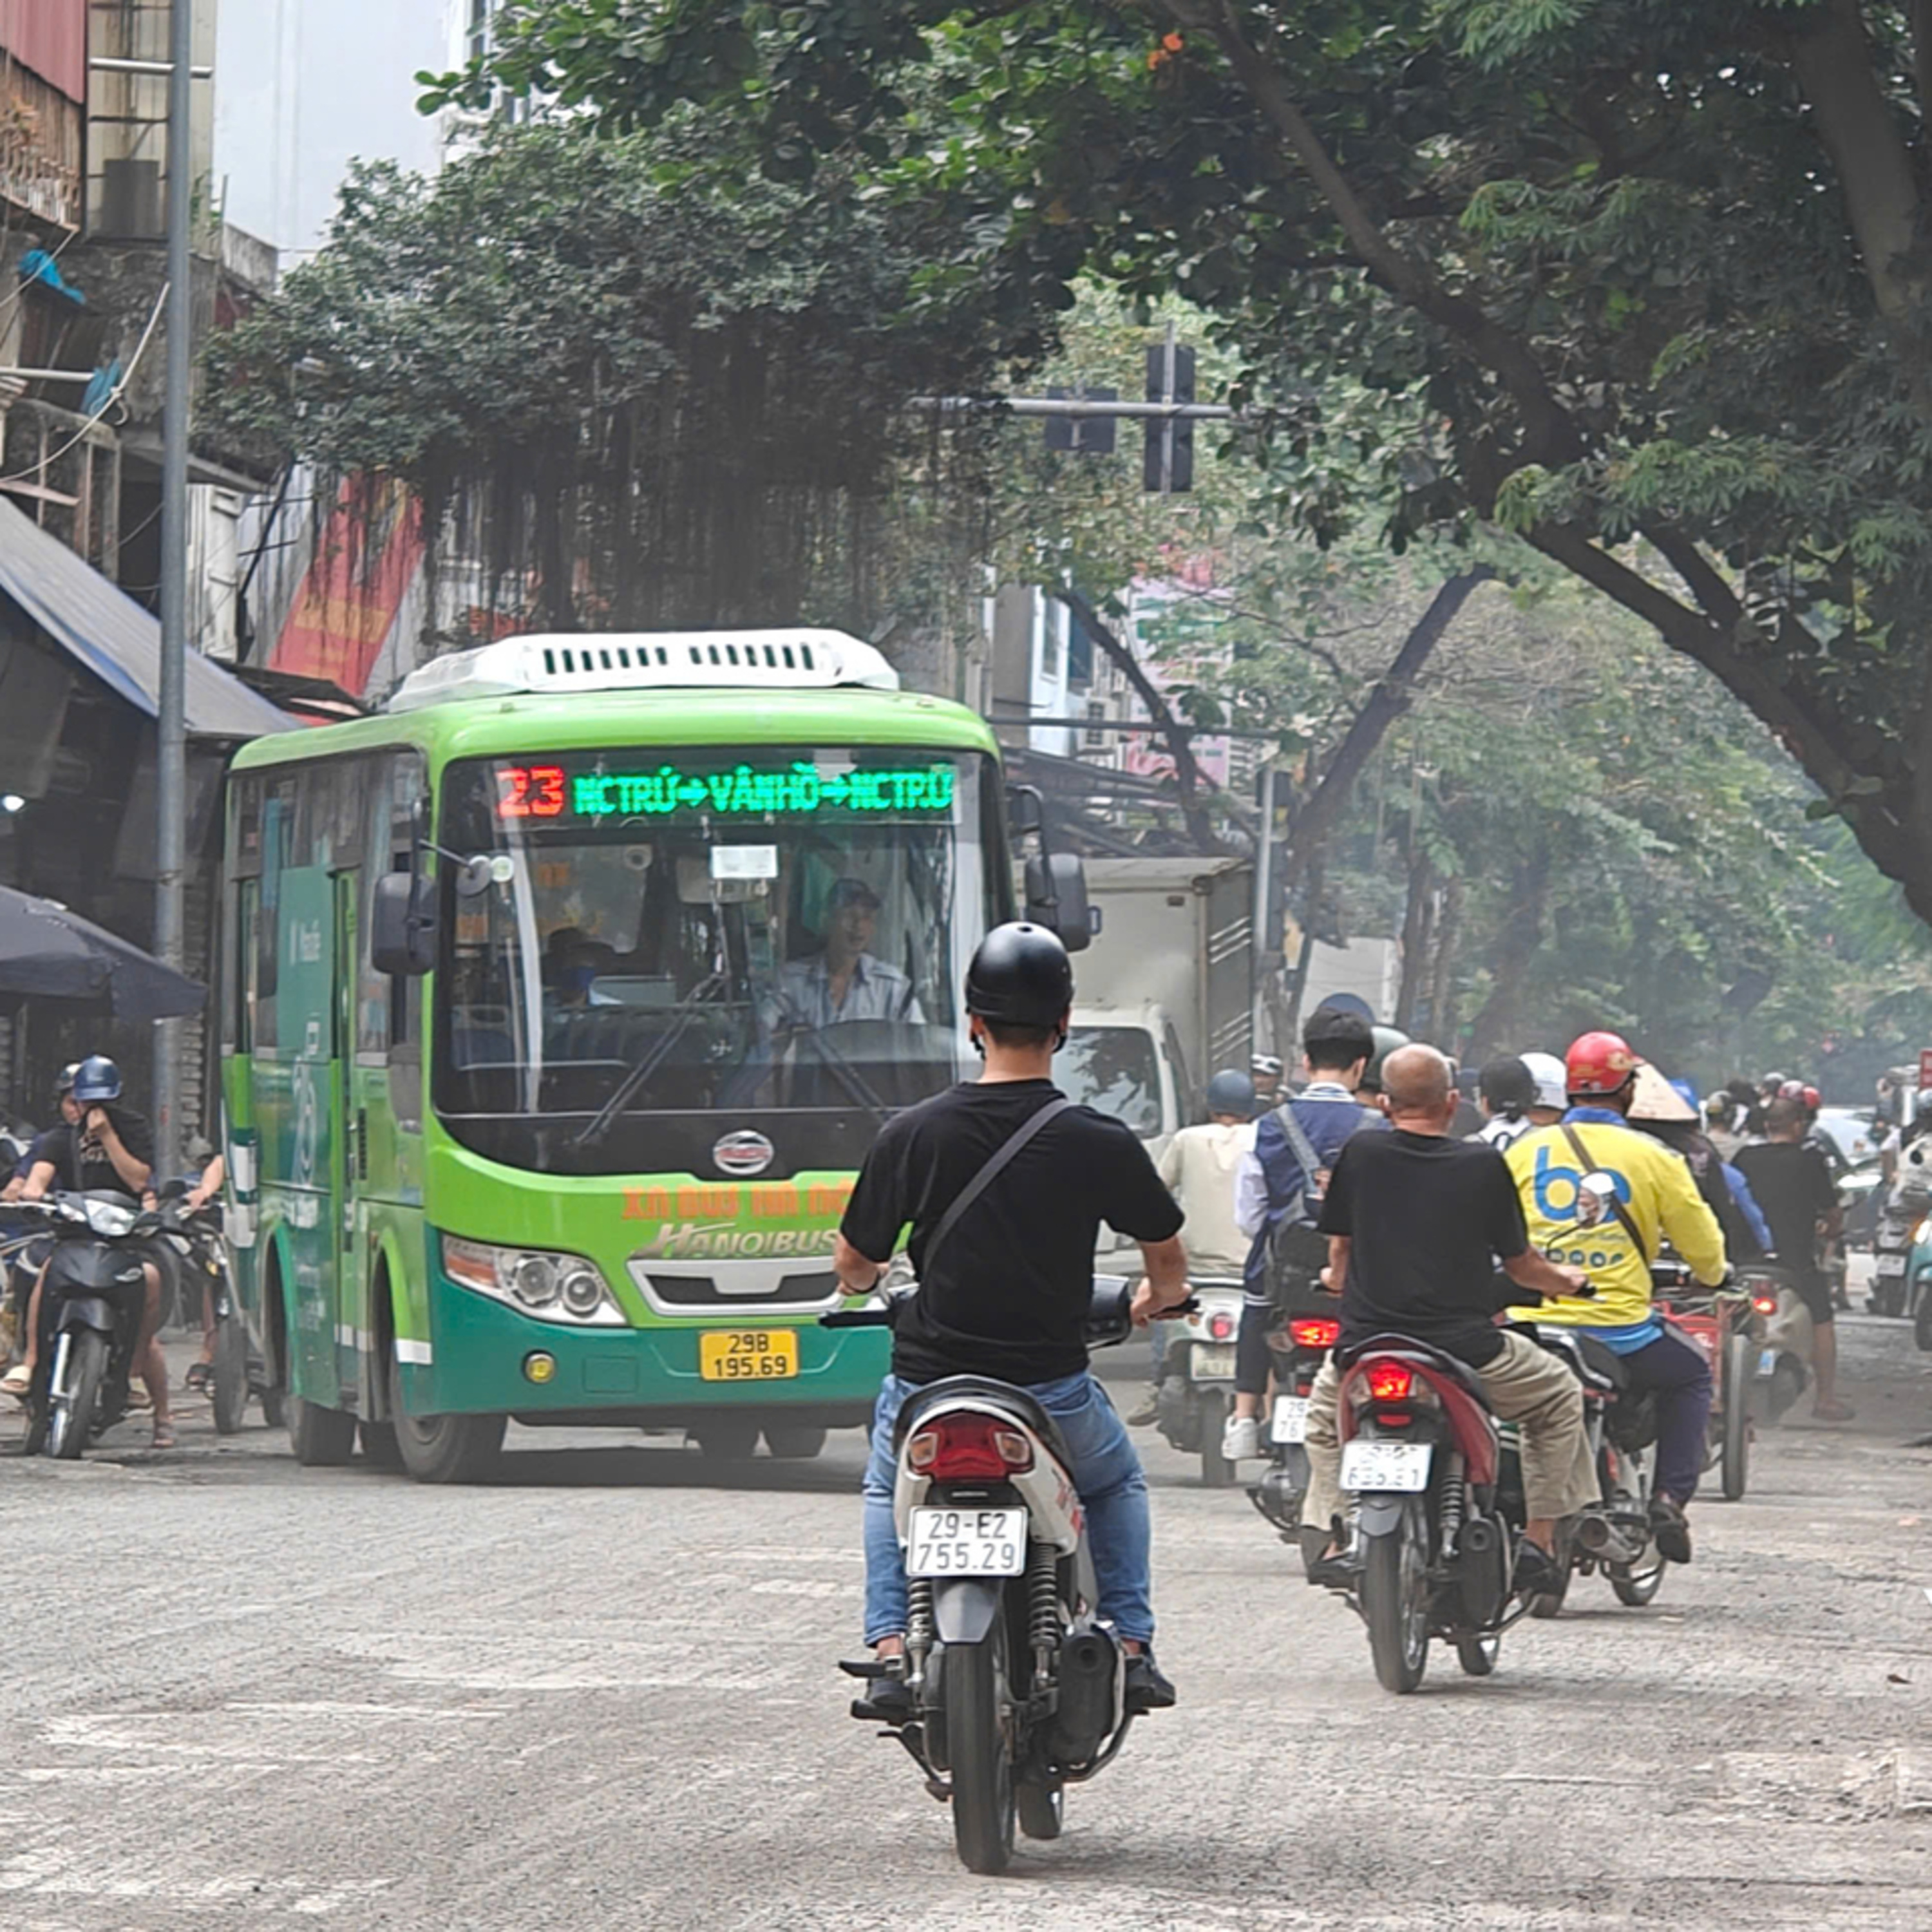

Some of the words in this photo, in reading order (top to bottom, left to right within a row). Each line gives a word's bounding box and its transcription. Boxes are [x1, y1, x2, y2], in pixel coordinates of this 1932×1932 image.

[498, 768, 564, 817] 23
[728, 1332, 770, 1354] 29B
[714, 1355, 787, 1378] 195.69
[918, 1542, 1016, 1571] 755.29
